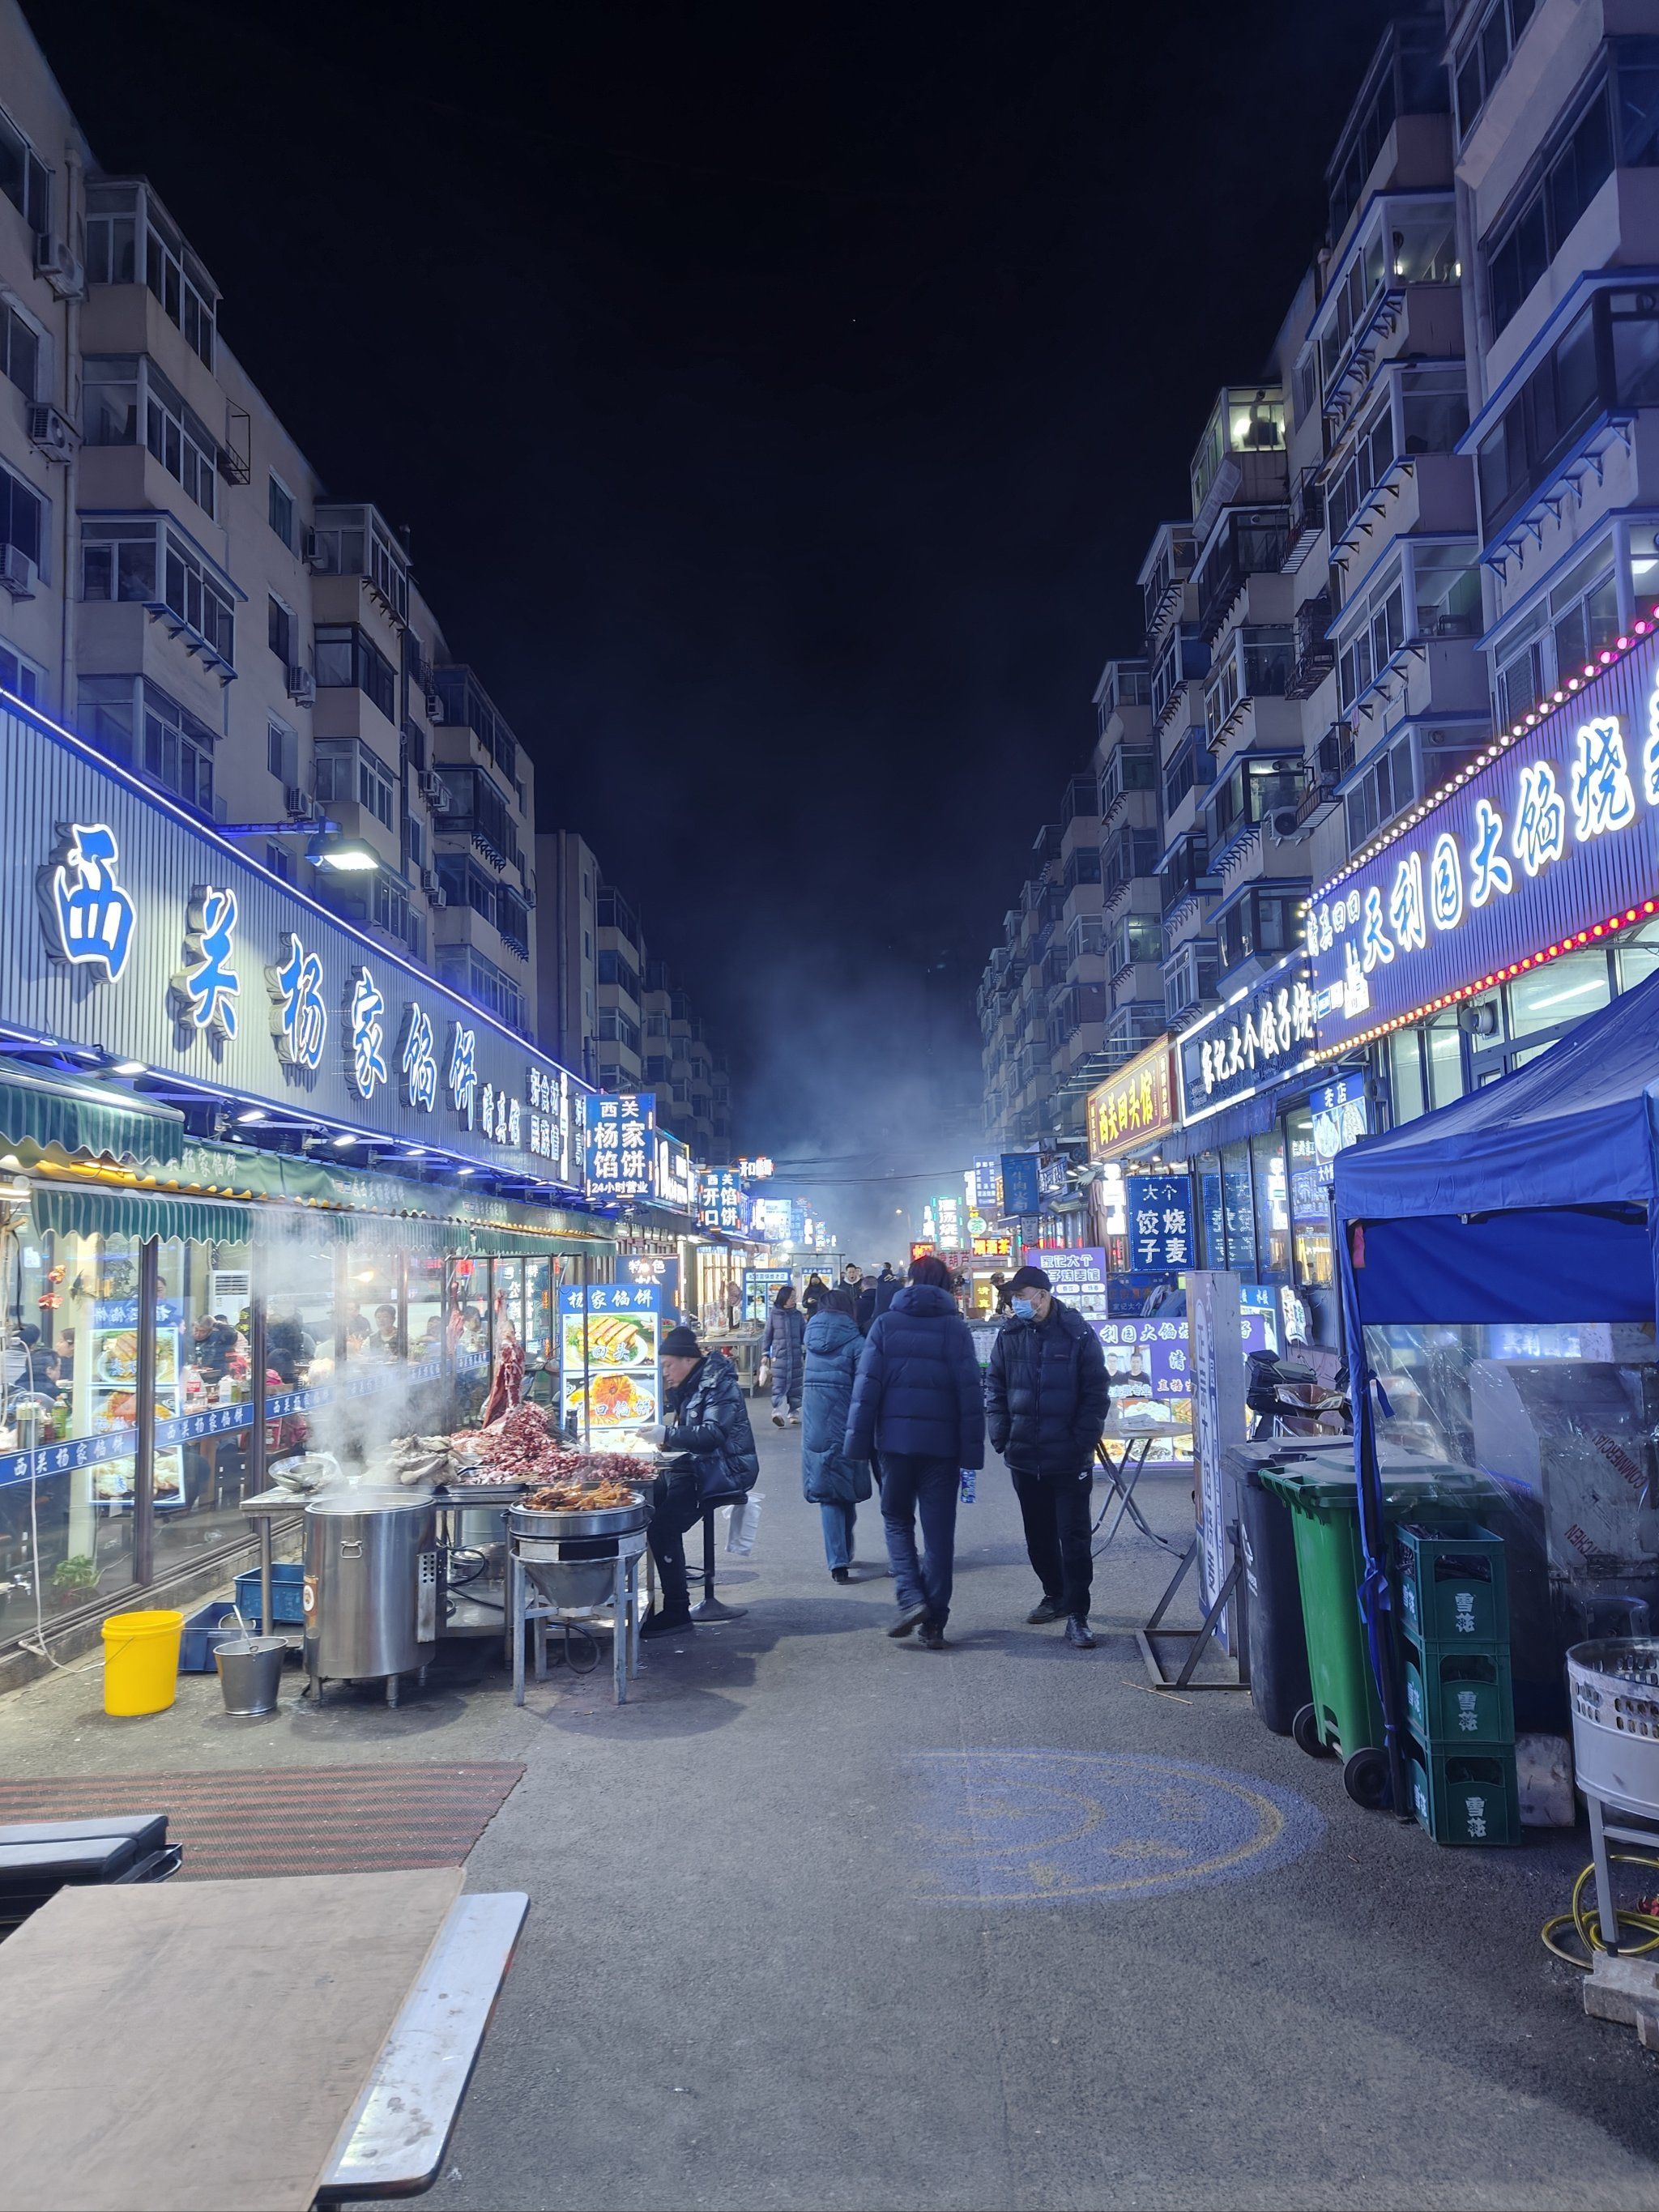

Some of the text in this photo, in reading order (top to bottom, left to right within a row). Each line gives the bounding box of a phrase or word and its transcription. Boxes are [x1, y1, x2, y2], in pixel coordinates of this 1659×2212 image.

[1363, 666, 1659, 973] 天利园大馅烧
[1307, 889, 1361, 957] 清真回回
[52, 822, 477, 1132] 西关杨家馅饼
[599, 1100, 640, 1119] 西关
[1098, 1068, 1154, 1146] 西关回头馆
[1324, 1081, 1348, 1108] 老店
[593, 1119, 646, 1149] 杨家
[592, 1149, 646, 1179] 馅饼
[591, 1181, 649, 1195] 24小时营业
[706, 1173, 734, 1186] 西关
[1142, 1183, 1178, 1202] 大个
[971, 1219, 983, 1231] 茶
[1136, 1209, 1161, 1264] 饺子
[1162, 1208, 1188, 1264] 烧麦
[1040, 1254, 1094, 1268] 家记大个
[1046, 1268, 1101, 1283] 子烧麦馆
[567, 1289, 654, 1310] 杨家馅饼
[592, 1343, 630, 1362] 回头
[1168, 1349, 1187, 1371] 清
[167, 1407, 245, 1440] 西关杨家馅饼
[13, 1434, 126, 1477] 西关杨家馅饼
[1454, 1592, 1476, 1634] 雪花
[1457, 1690, 1478, 1732] 雪花
[1465, 1796, 1487, 1839] 雪花
